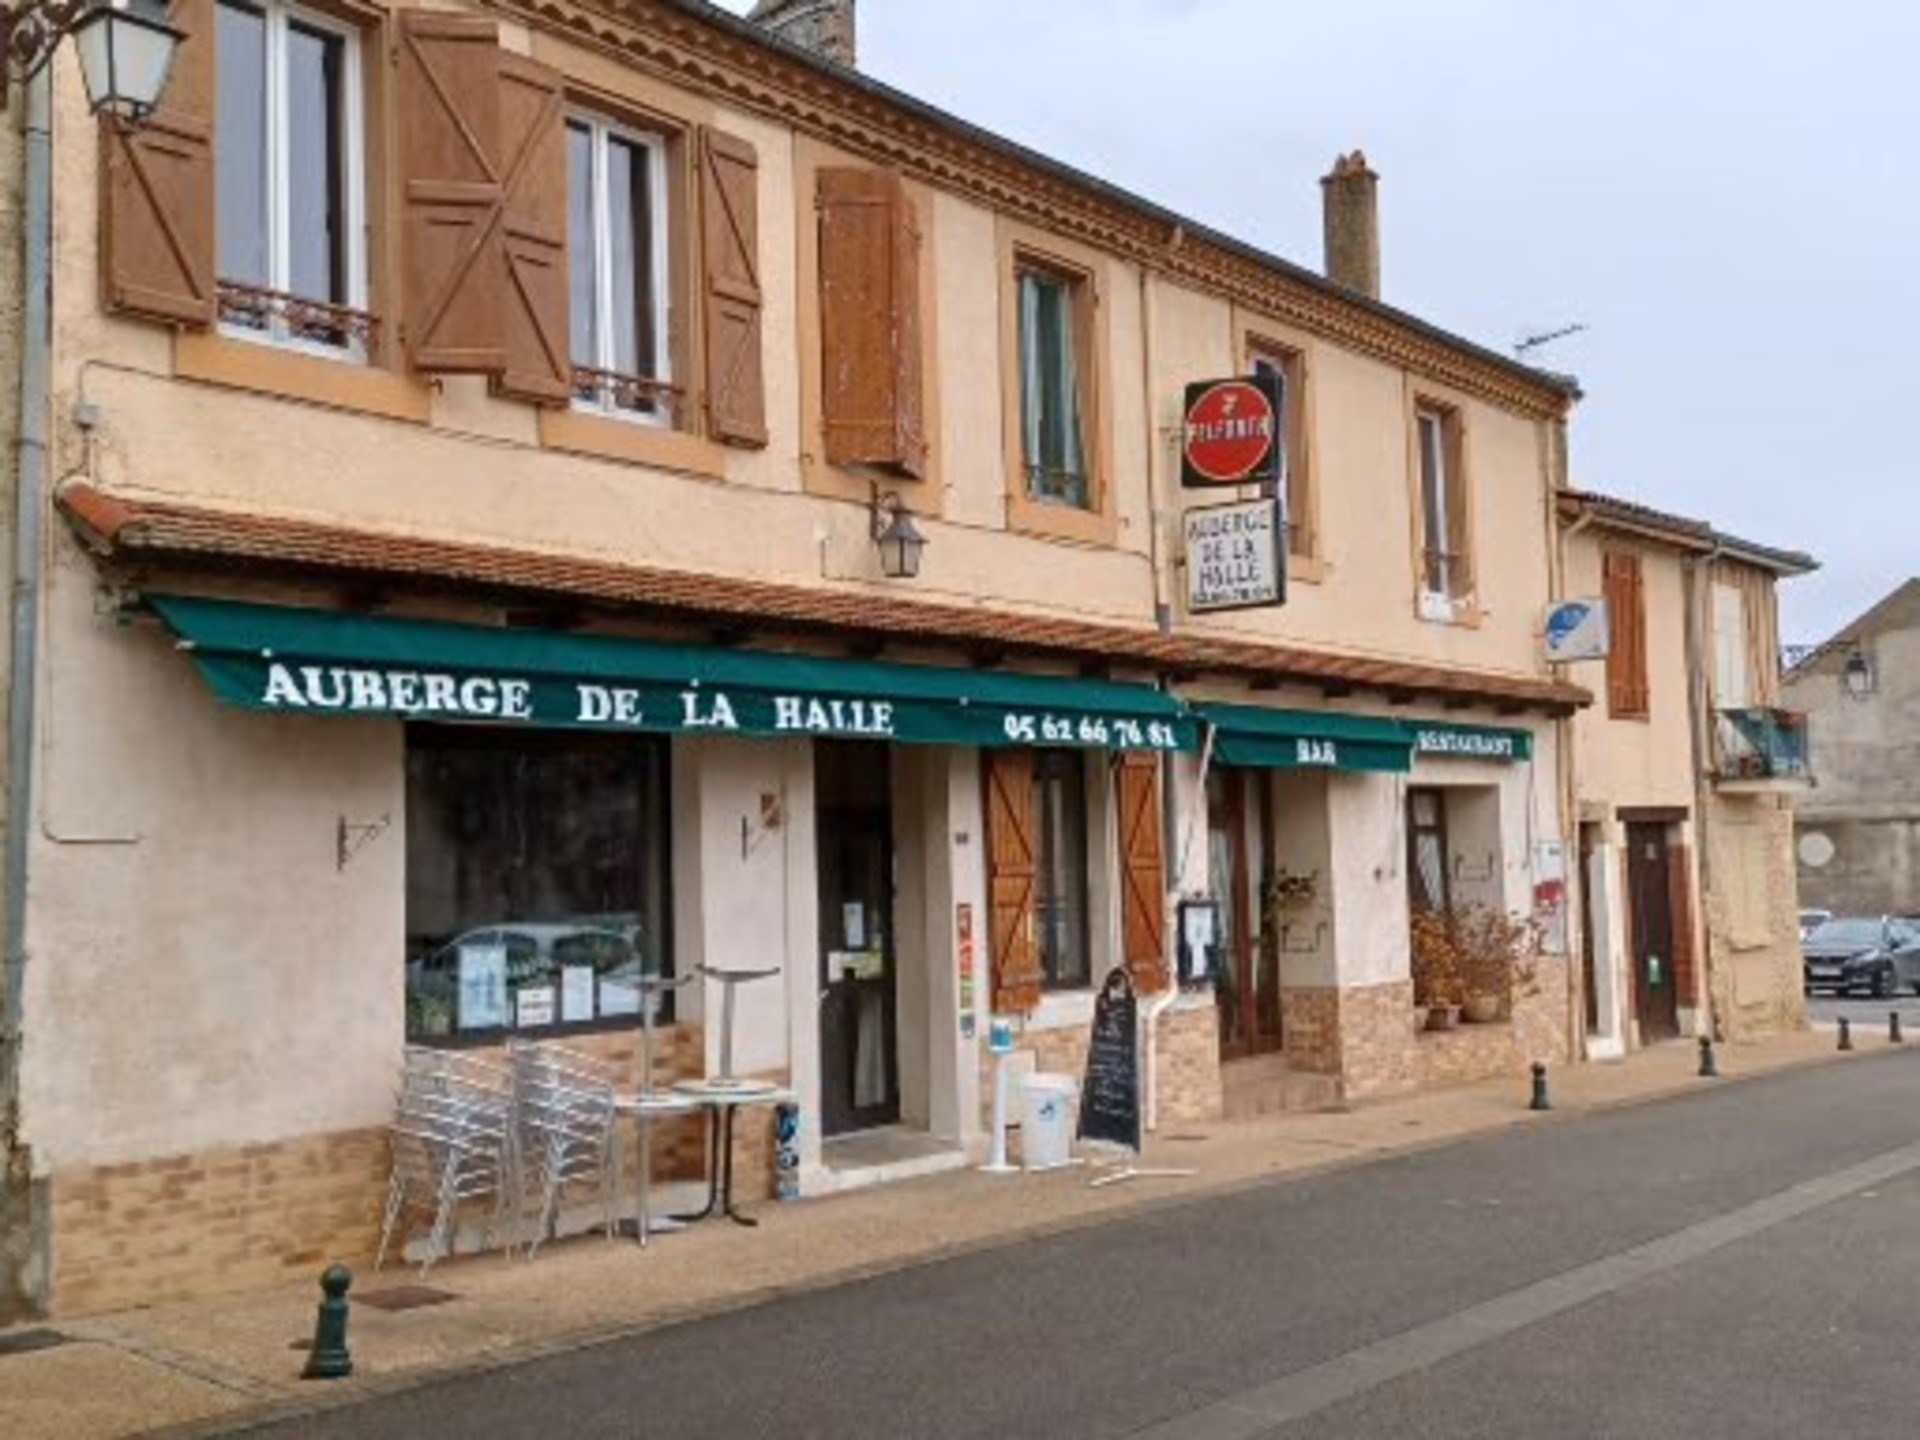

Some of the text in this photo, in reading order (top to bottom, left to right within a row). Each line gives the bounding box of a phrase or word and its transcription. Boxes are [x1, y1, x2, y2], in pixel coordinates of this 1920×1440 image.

[1188, 509, 1270, 542] AUBERGE
[1201, 538, 1256, 563] DE LA
[1199, 562, 1261, 590] HALLE
[261, 662, 895, 735] AUBERGE DE LA HALLE
[1004, 712, 1178, 748] 05 62 66 76 81
[1416, 730, 1513, 756] RESTAURANT
[1296, 738, 1337, 765] BAR
